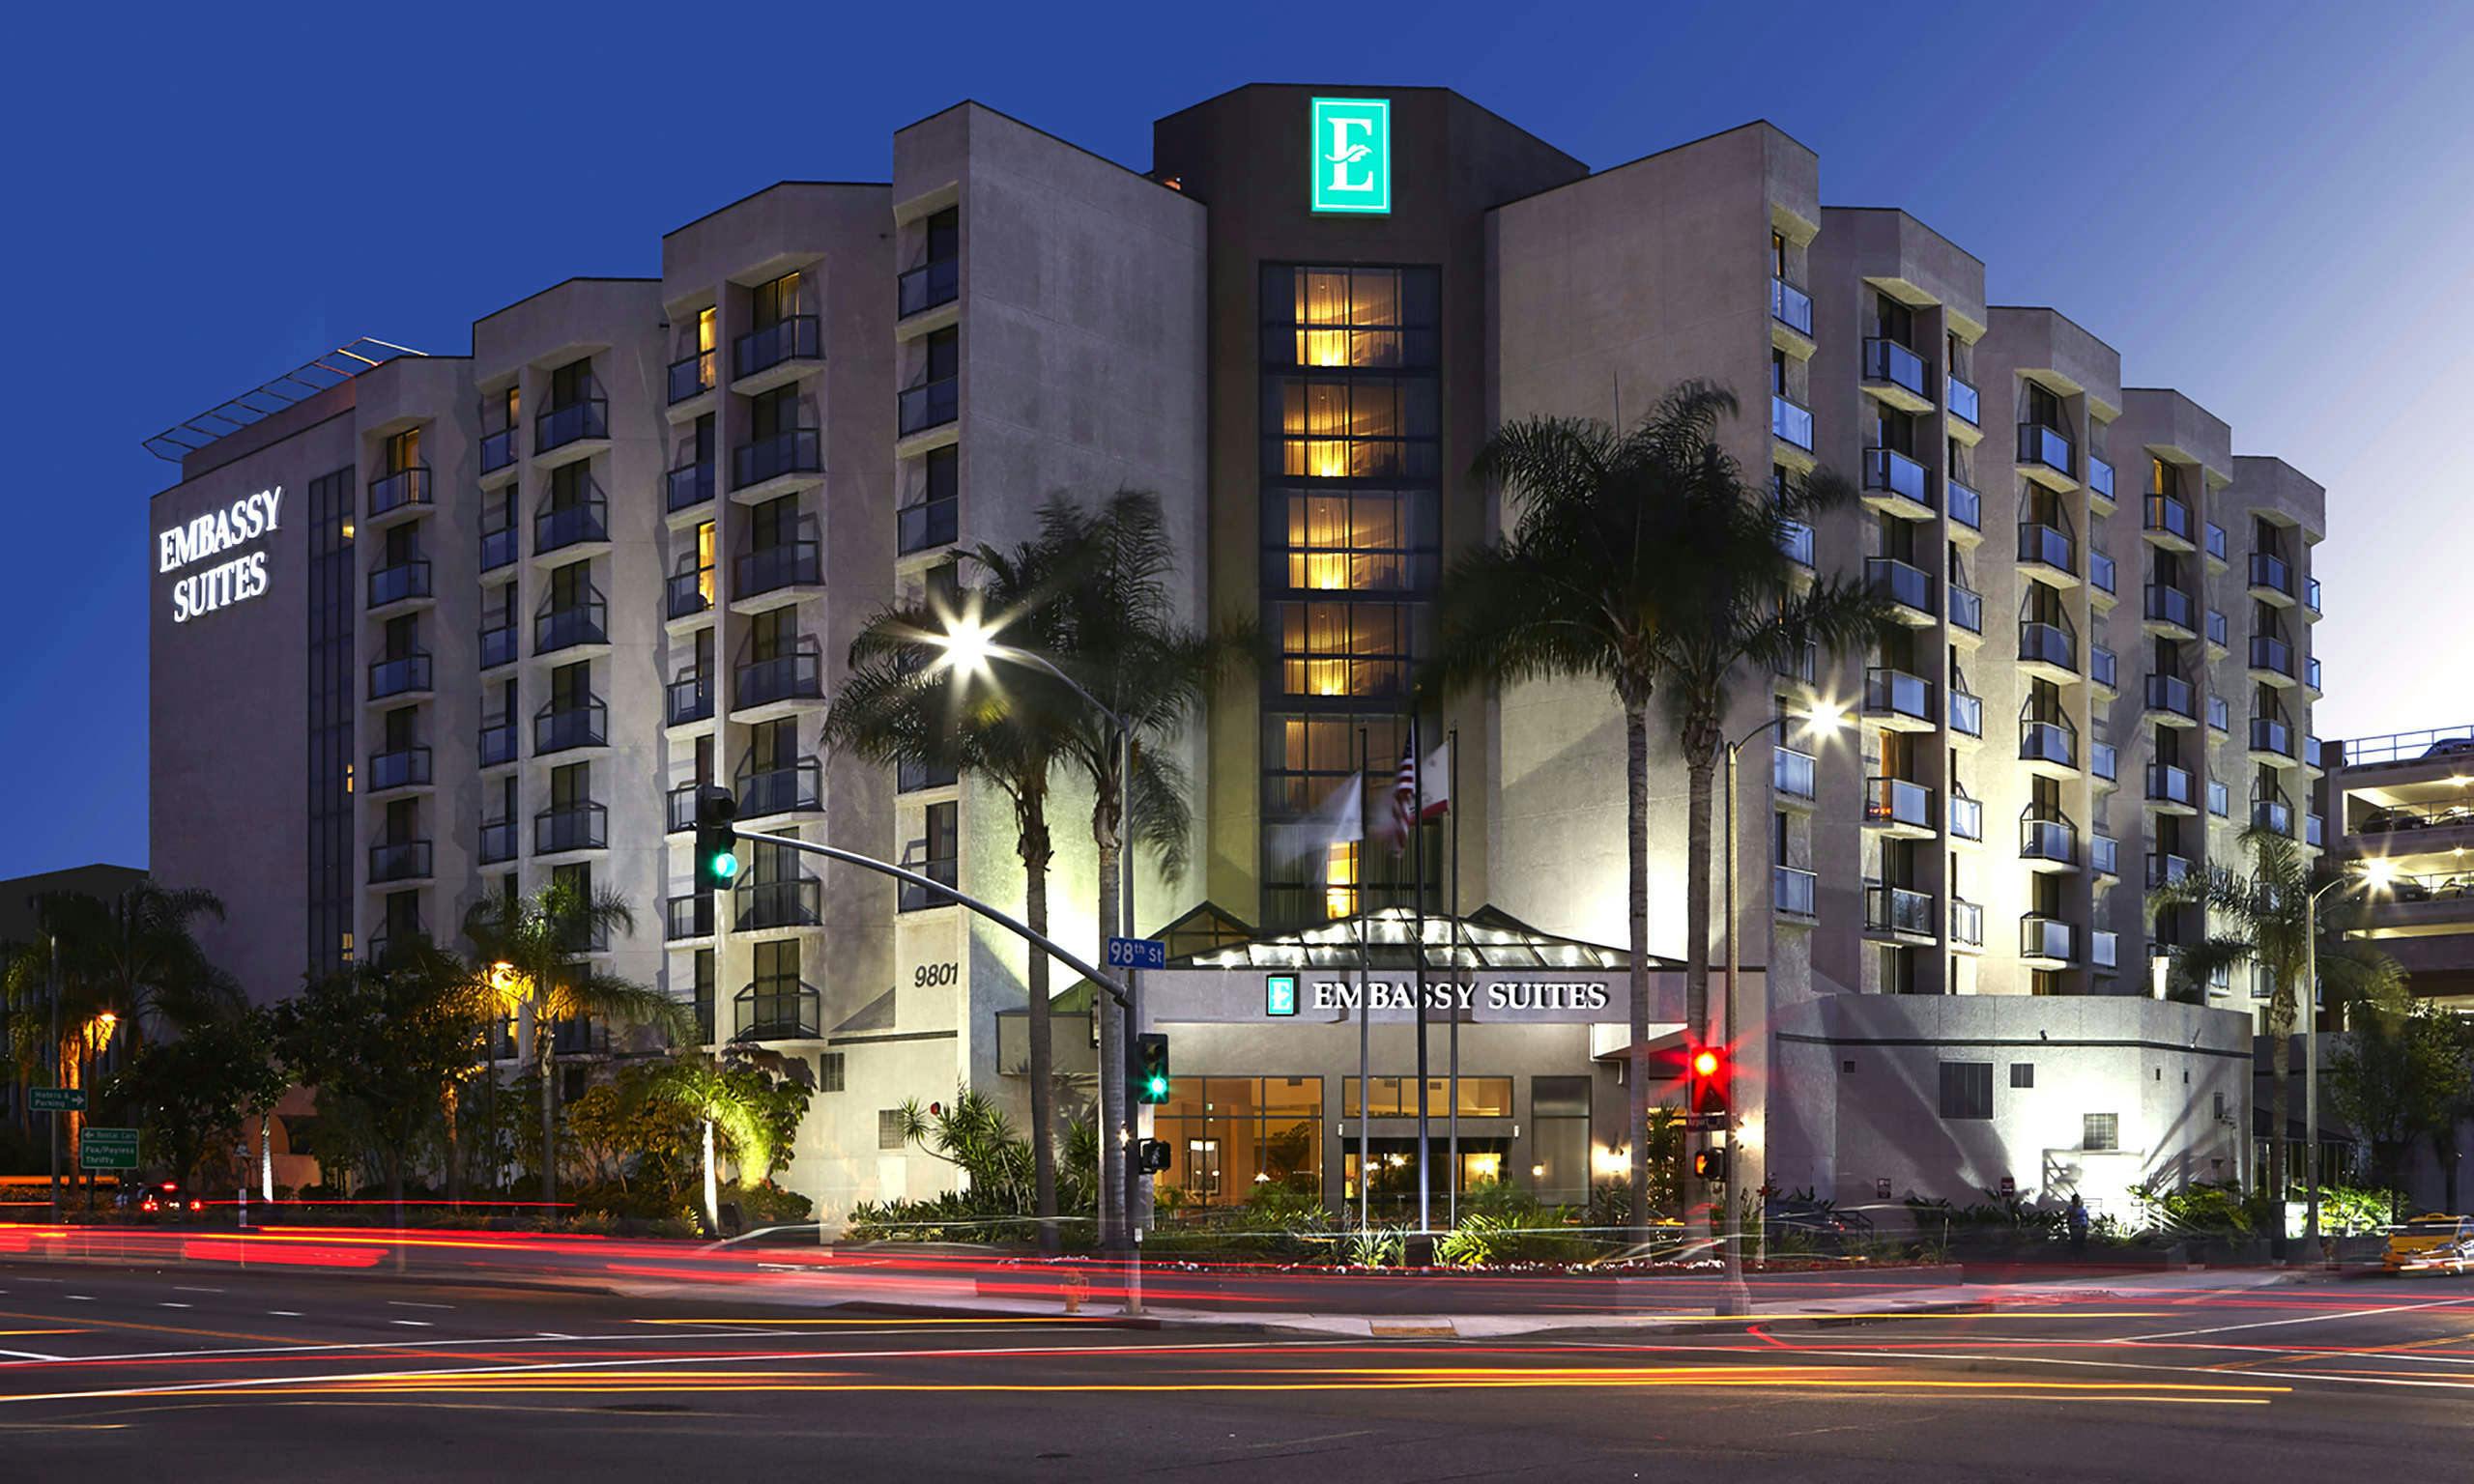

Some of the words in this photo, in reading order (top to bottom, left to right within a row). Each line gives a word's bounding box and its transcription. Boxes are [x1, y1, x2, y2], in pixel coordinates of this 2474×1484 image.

[1324, 117, 1374, 191] E
[159, 485, 282, 573] EMBASSY
[174, 551, 267, 622] SUITES
[1110, 941, 1145, 964] 98th
[1148, 947, 1163, 963] St
[914, 962, 959, 987] 9801
[1272, 981, 1291, 1011] E
[1487, 982, 1607, 1010] SUITES
[35, 1099, 66, 1108] Parking
[85, 1156, 115, 1165] Thrifty
